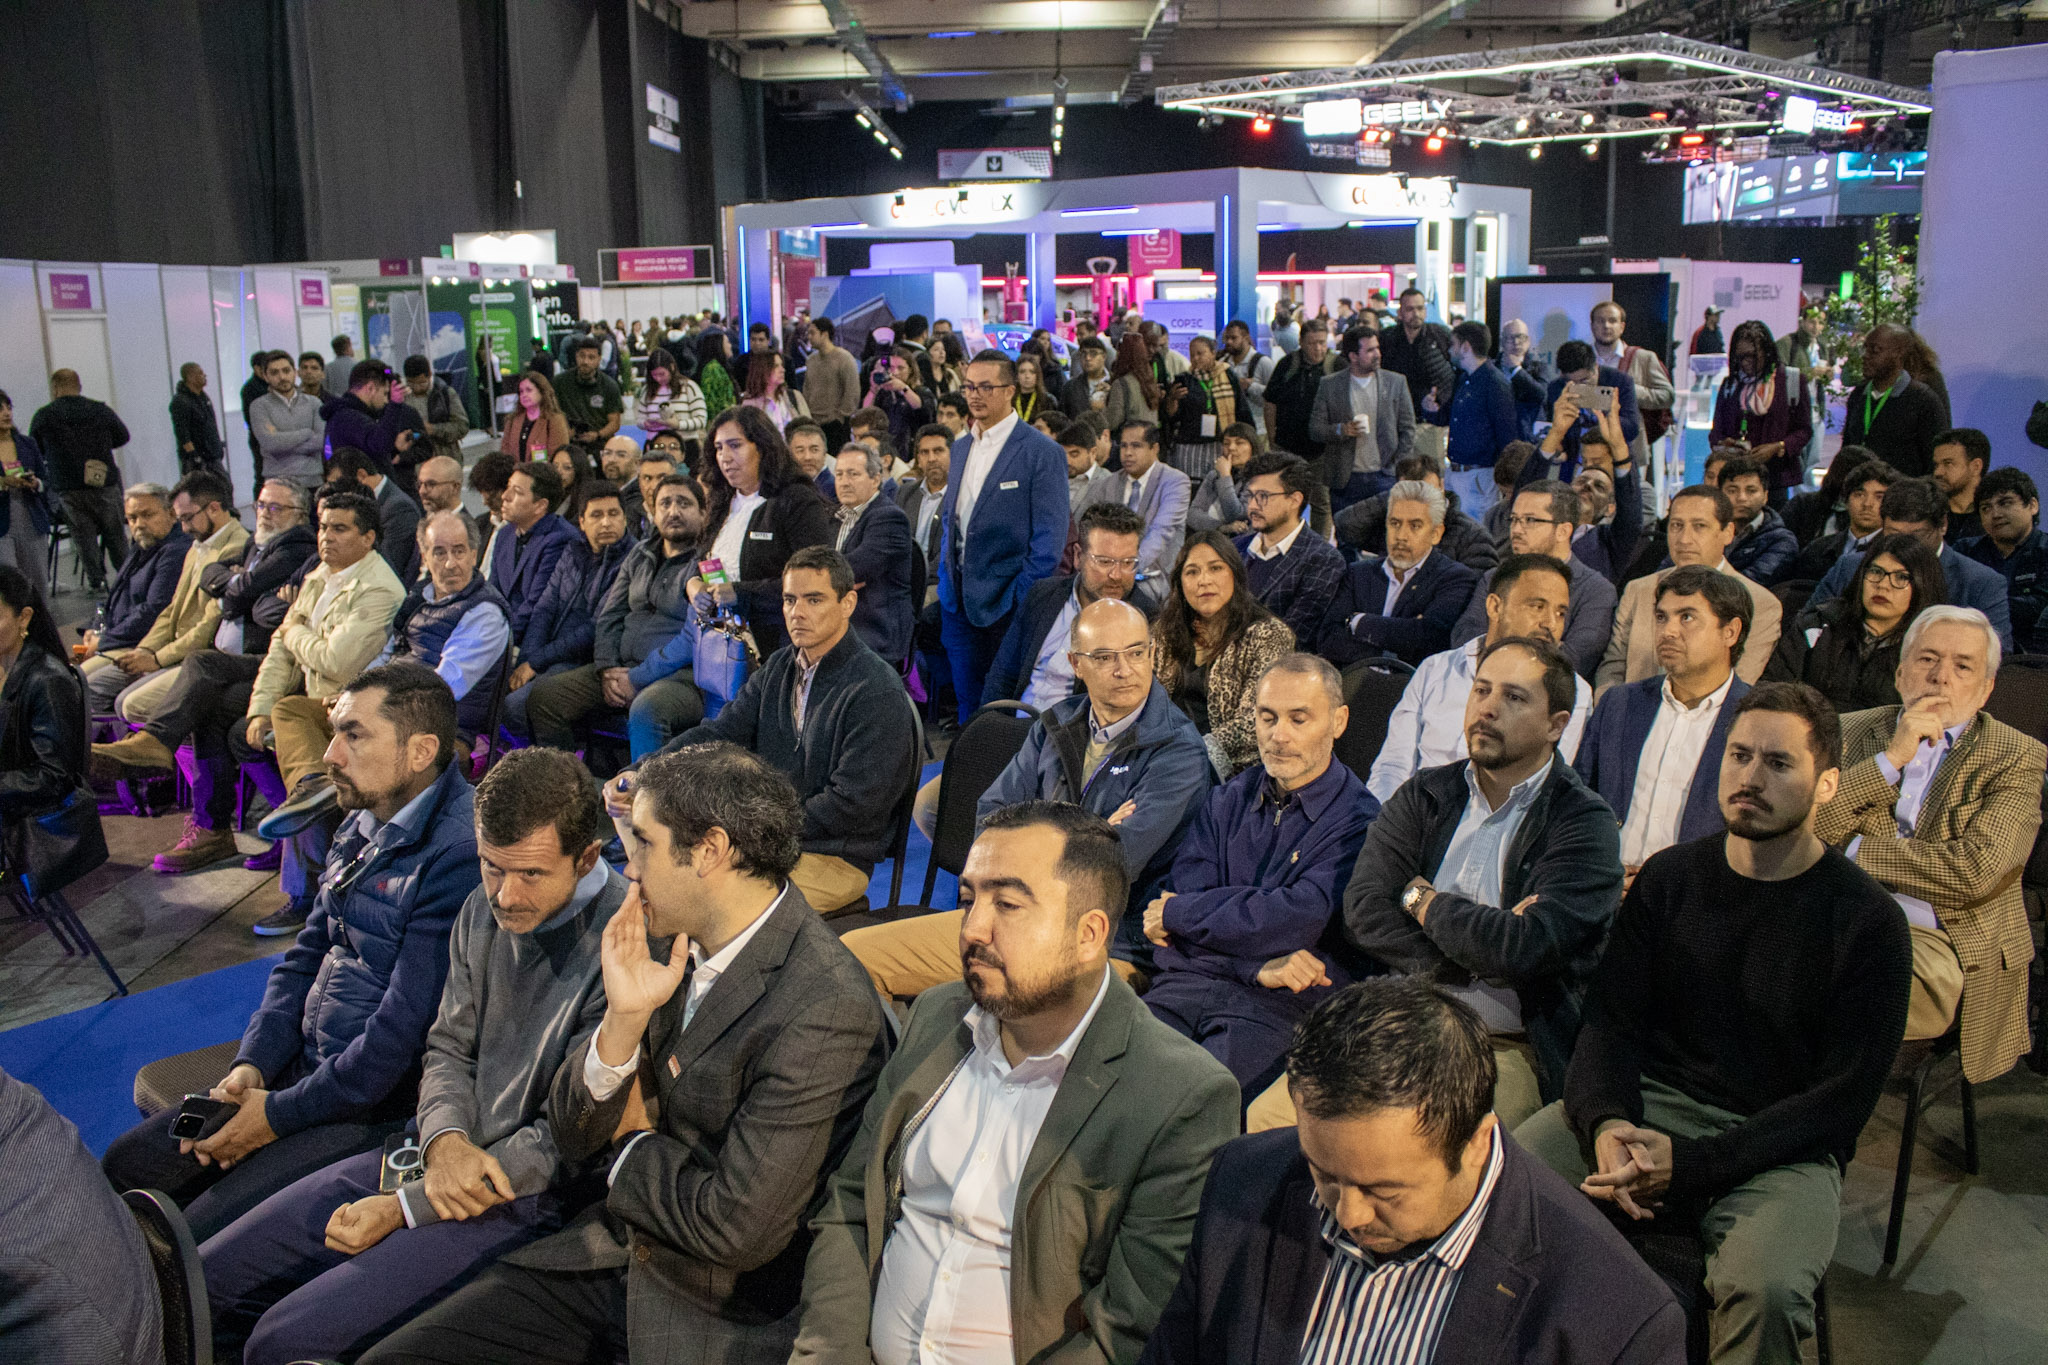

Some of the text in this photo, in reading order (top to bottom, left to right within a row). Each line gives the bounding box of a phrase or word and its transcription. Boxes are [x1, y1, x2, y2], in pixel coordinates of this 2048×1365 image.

[1363, 99, 1452, 125] GEELY
[1815, 108, 1860, 132] GEELY
[666, 256, 688, 264] VENTA
[1743, 283, 1783, 301] GEELY
[1170, 318, 1204, 329] COPEC
